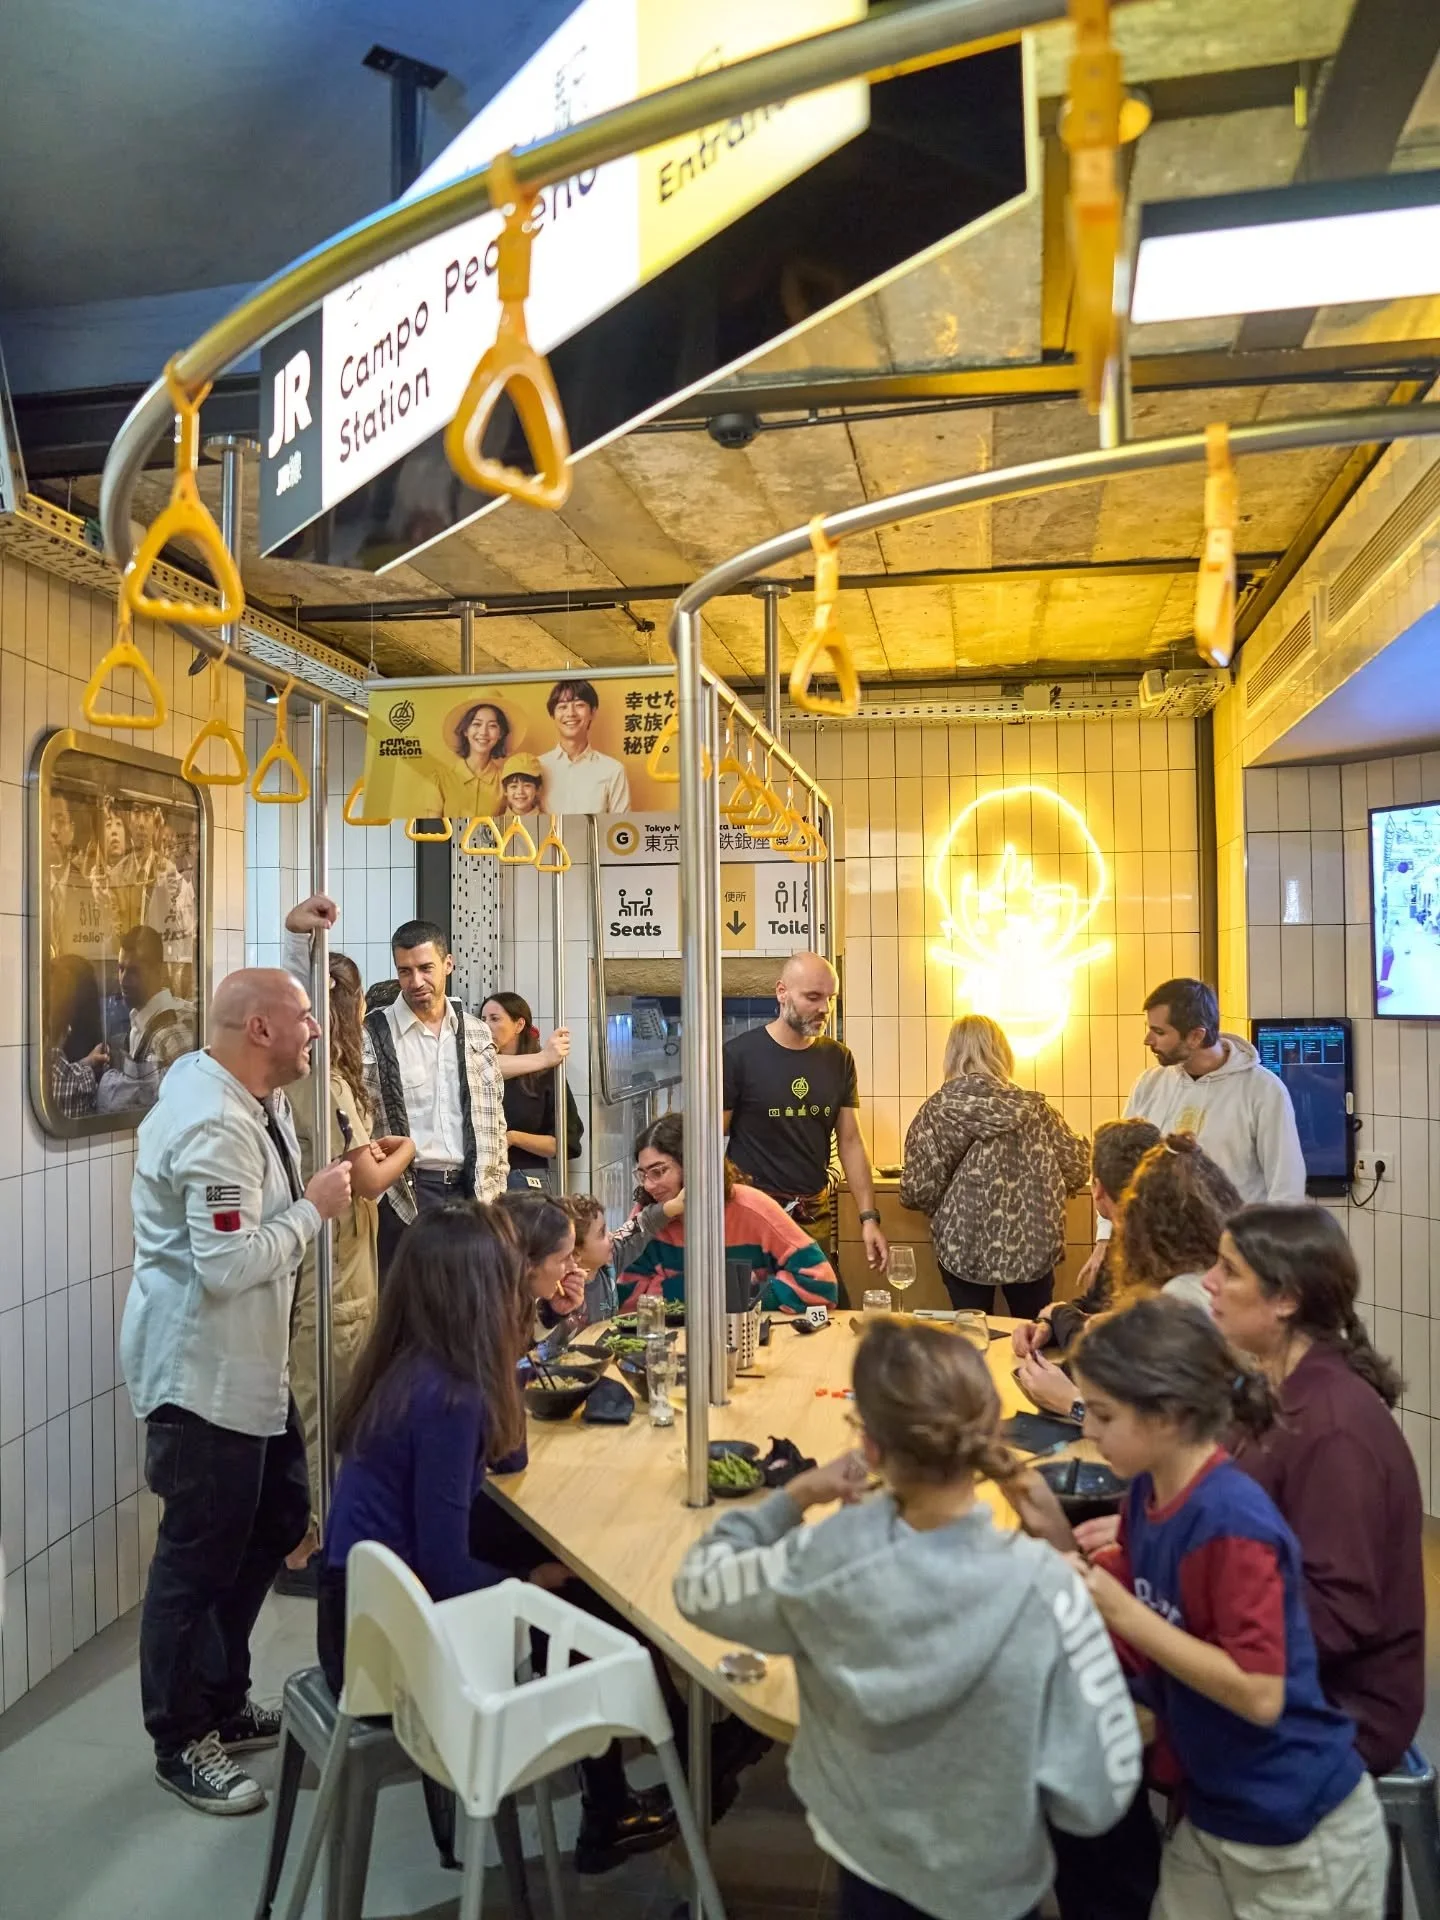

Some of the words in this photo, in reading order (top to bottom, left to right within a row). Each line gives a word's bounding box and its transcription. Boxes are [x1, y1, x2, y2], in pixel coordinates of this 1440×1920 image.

[340, 301, 429, 399] Campo
[268, 349, 313, 460] JR
[340, 367, 430, 463] Station
[380, 738, 420, 748] ramen
[379, 747, 422, 756] station
[644, 825, 671, 833] Tokyo
[616, 832, 629, 845] G
[724, 891, 746, 903] 便所
[610, 922, 661, 936] Seats
[768, 920, 826, 934] Toiles
[811, 1311, 826, 1322] 35
